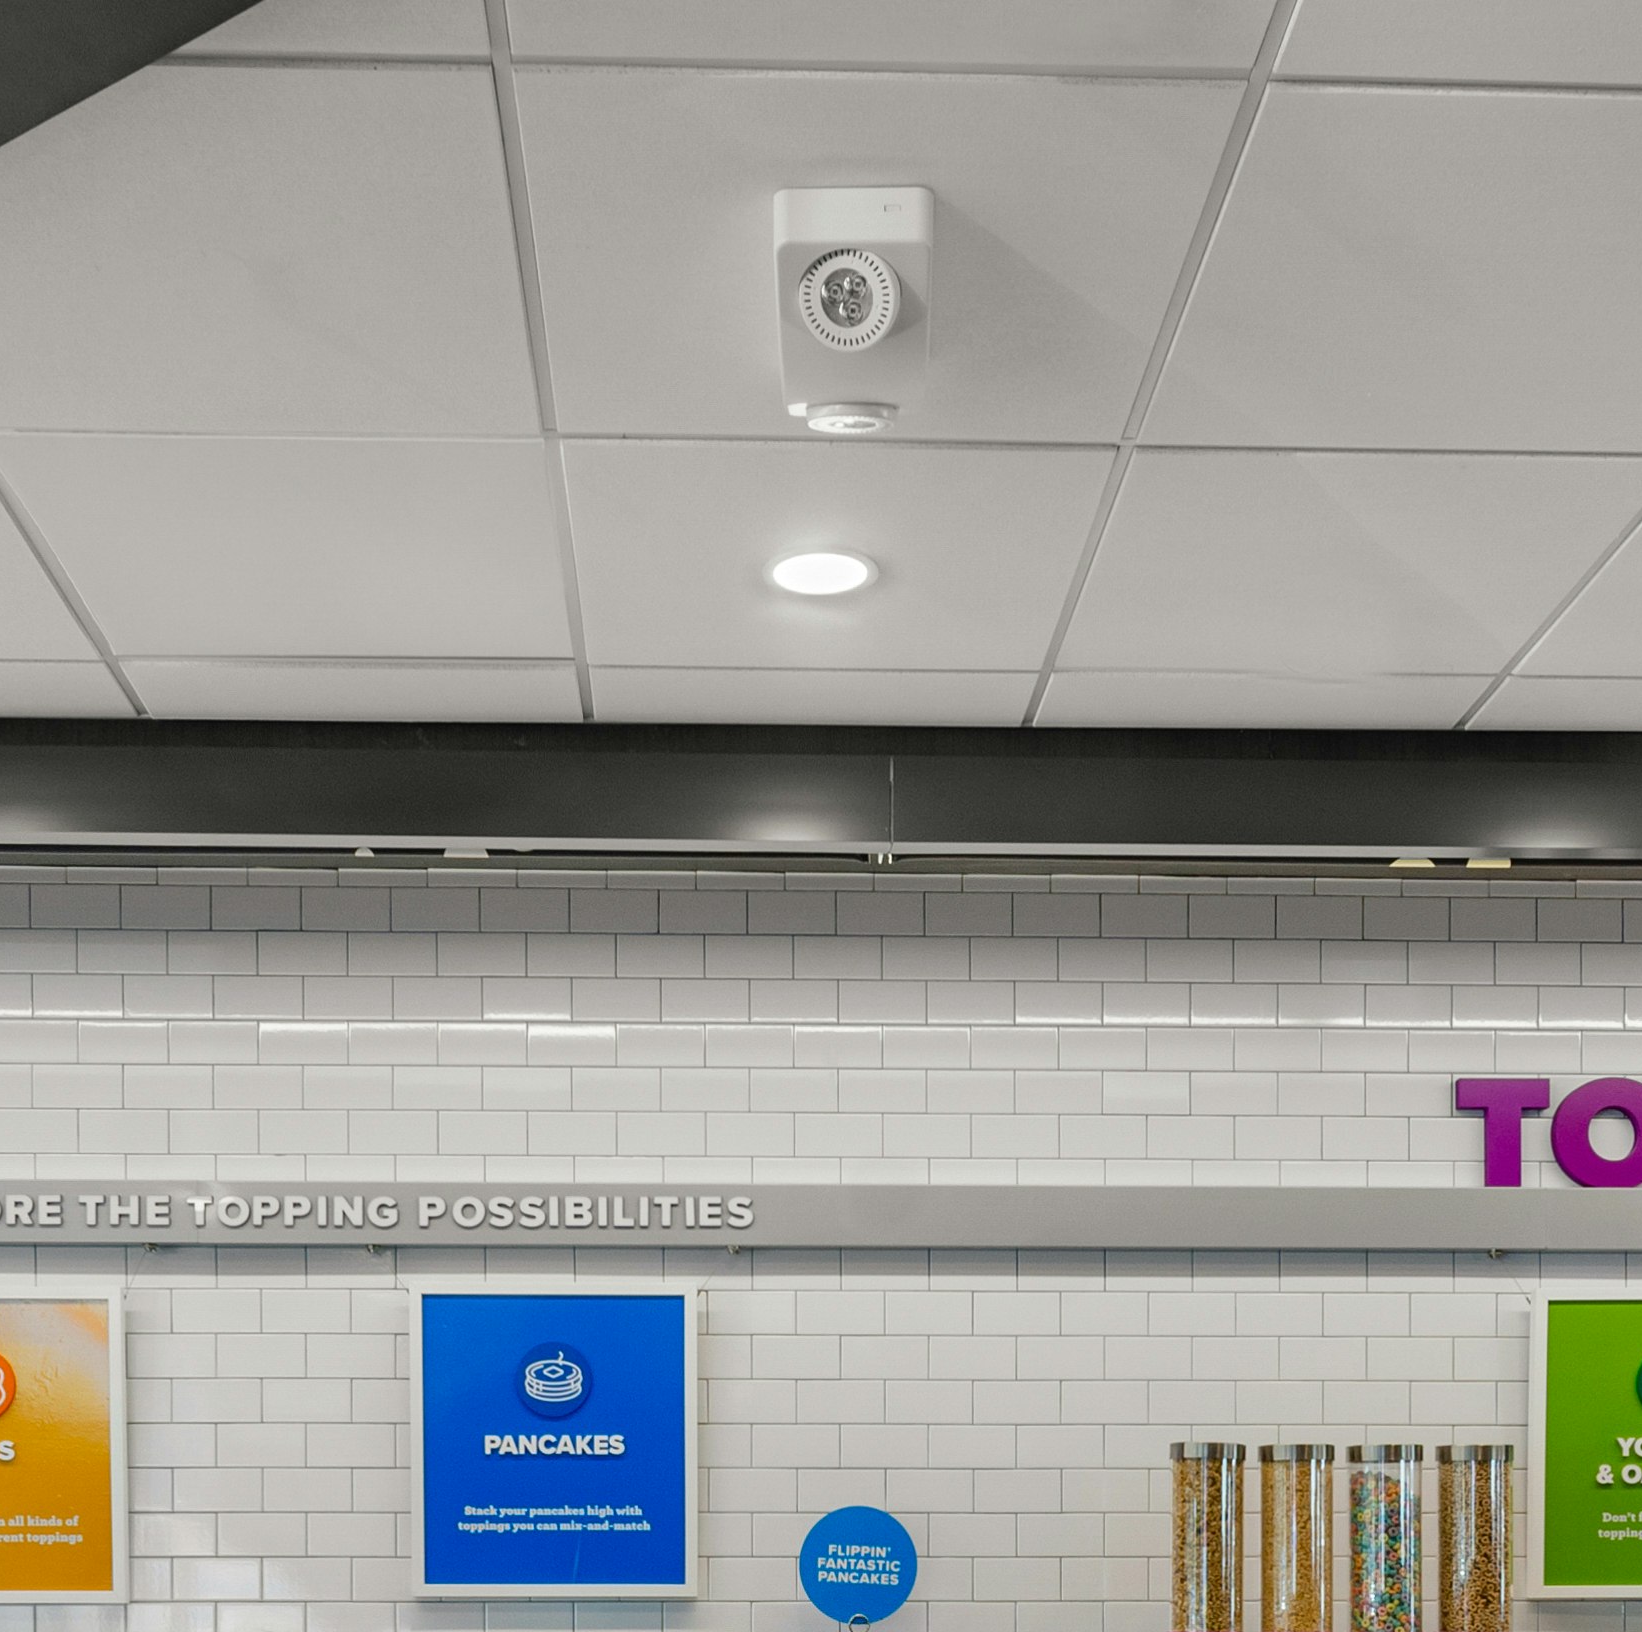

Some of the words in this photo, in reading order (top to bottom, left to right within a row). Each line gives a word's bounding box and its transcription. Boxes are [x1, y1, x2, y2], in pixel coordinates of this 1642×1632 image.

[78, 1195, 171, 1227] THE
[187, 1195, 399, 1228] TOPPING
[418, 1195, 755, 1229] POSSIBILITIES
[484, 1434, 626, 1455] PANCAKES
[1596, 1464, 1614, 1484] &
[464, 1505, 497, 1516] Stack
[499, 1507, 527, 1518] your
[529, 1505, 585, 1518] pancakes
[587, 1505, 614, 1518] high
[616, 1505, 642, 1516] with
[1602, 1511, 1636, 1522] Don't
[8, 1515, 24, 1527] all
[27, 1515, 62, 1527] kinds
[65, 1515, 80, 1527] of
[458, 1520, 510, 1533] toppings
[512, 1522, 534, 1533] you
[536, 1522, 557, 1530] can
[559, 1520, 651, 1531] mix-and-match
[26, 1532, 83, 1544] toppings
[828, 1544, 891, 1558] FLIPPIN'
[817, 1557, 901, 1572] FANTASTIC
[818, 1571, 899, 1585] PANCAKES
